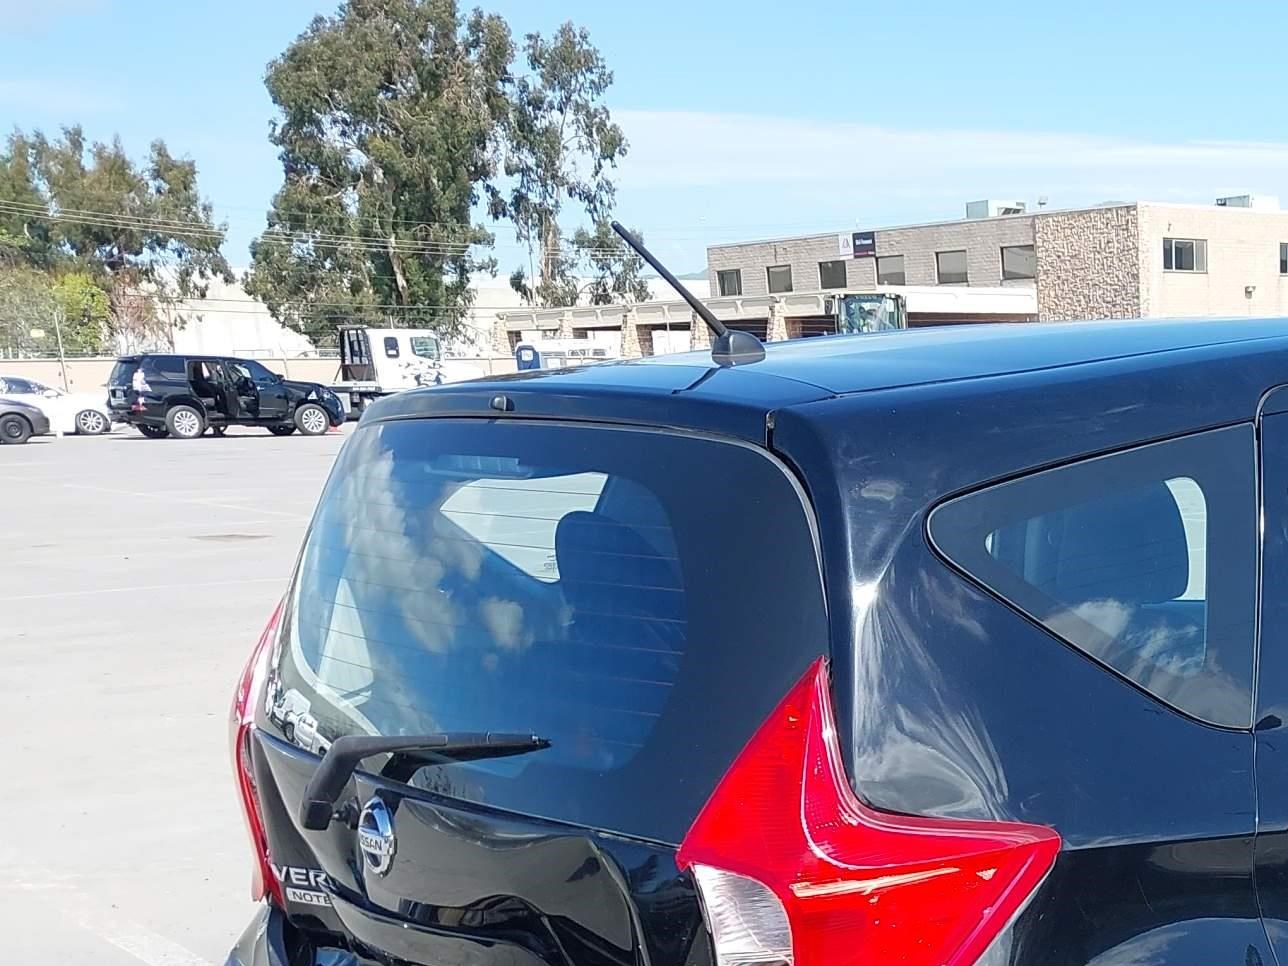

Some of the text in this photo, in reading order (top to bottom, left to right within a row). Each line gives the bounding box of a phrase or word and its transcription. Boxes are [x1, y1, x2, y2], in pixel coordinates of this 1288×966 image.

[360, 833, 382, 851] SSAN
[270, 863, 331, 888] VER
[291, 890, 332, 905] NOTE
